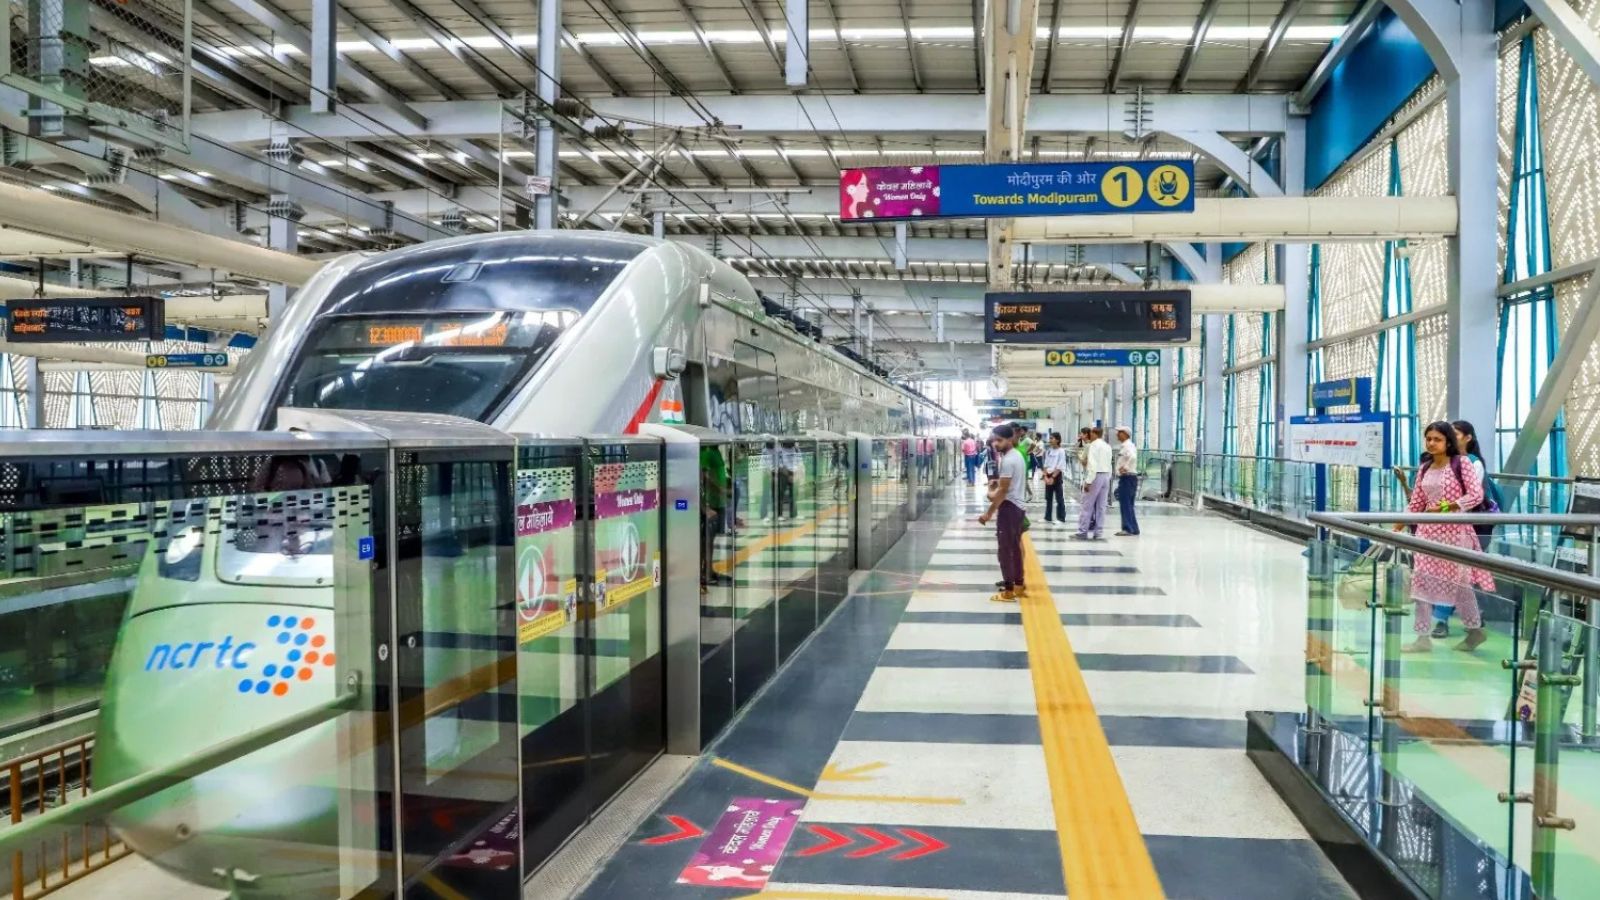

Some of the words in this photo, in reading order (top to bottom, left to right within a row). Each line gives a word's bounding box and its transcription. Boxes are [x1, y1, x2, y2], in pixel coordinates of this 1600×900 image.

[1007, 171, 1053, 189] मोदीपुरम
[1057, 170, 1072, 185] की
[1076, 170, 1097, 184] ओर
[1112, 171, 1128, 202] 1
[883, 193, 909, 201] Women
[909, 191, 927, 201] Only
[973, 193, 1024, 205] Towards
[1028, 191, 1098, 205] Modipuram
[145, 635, 256, 672] ncrtc
